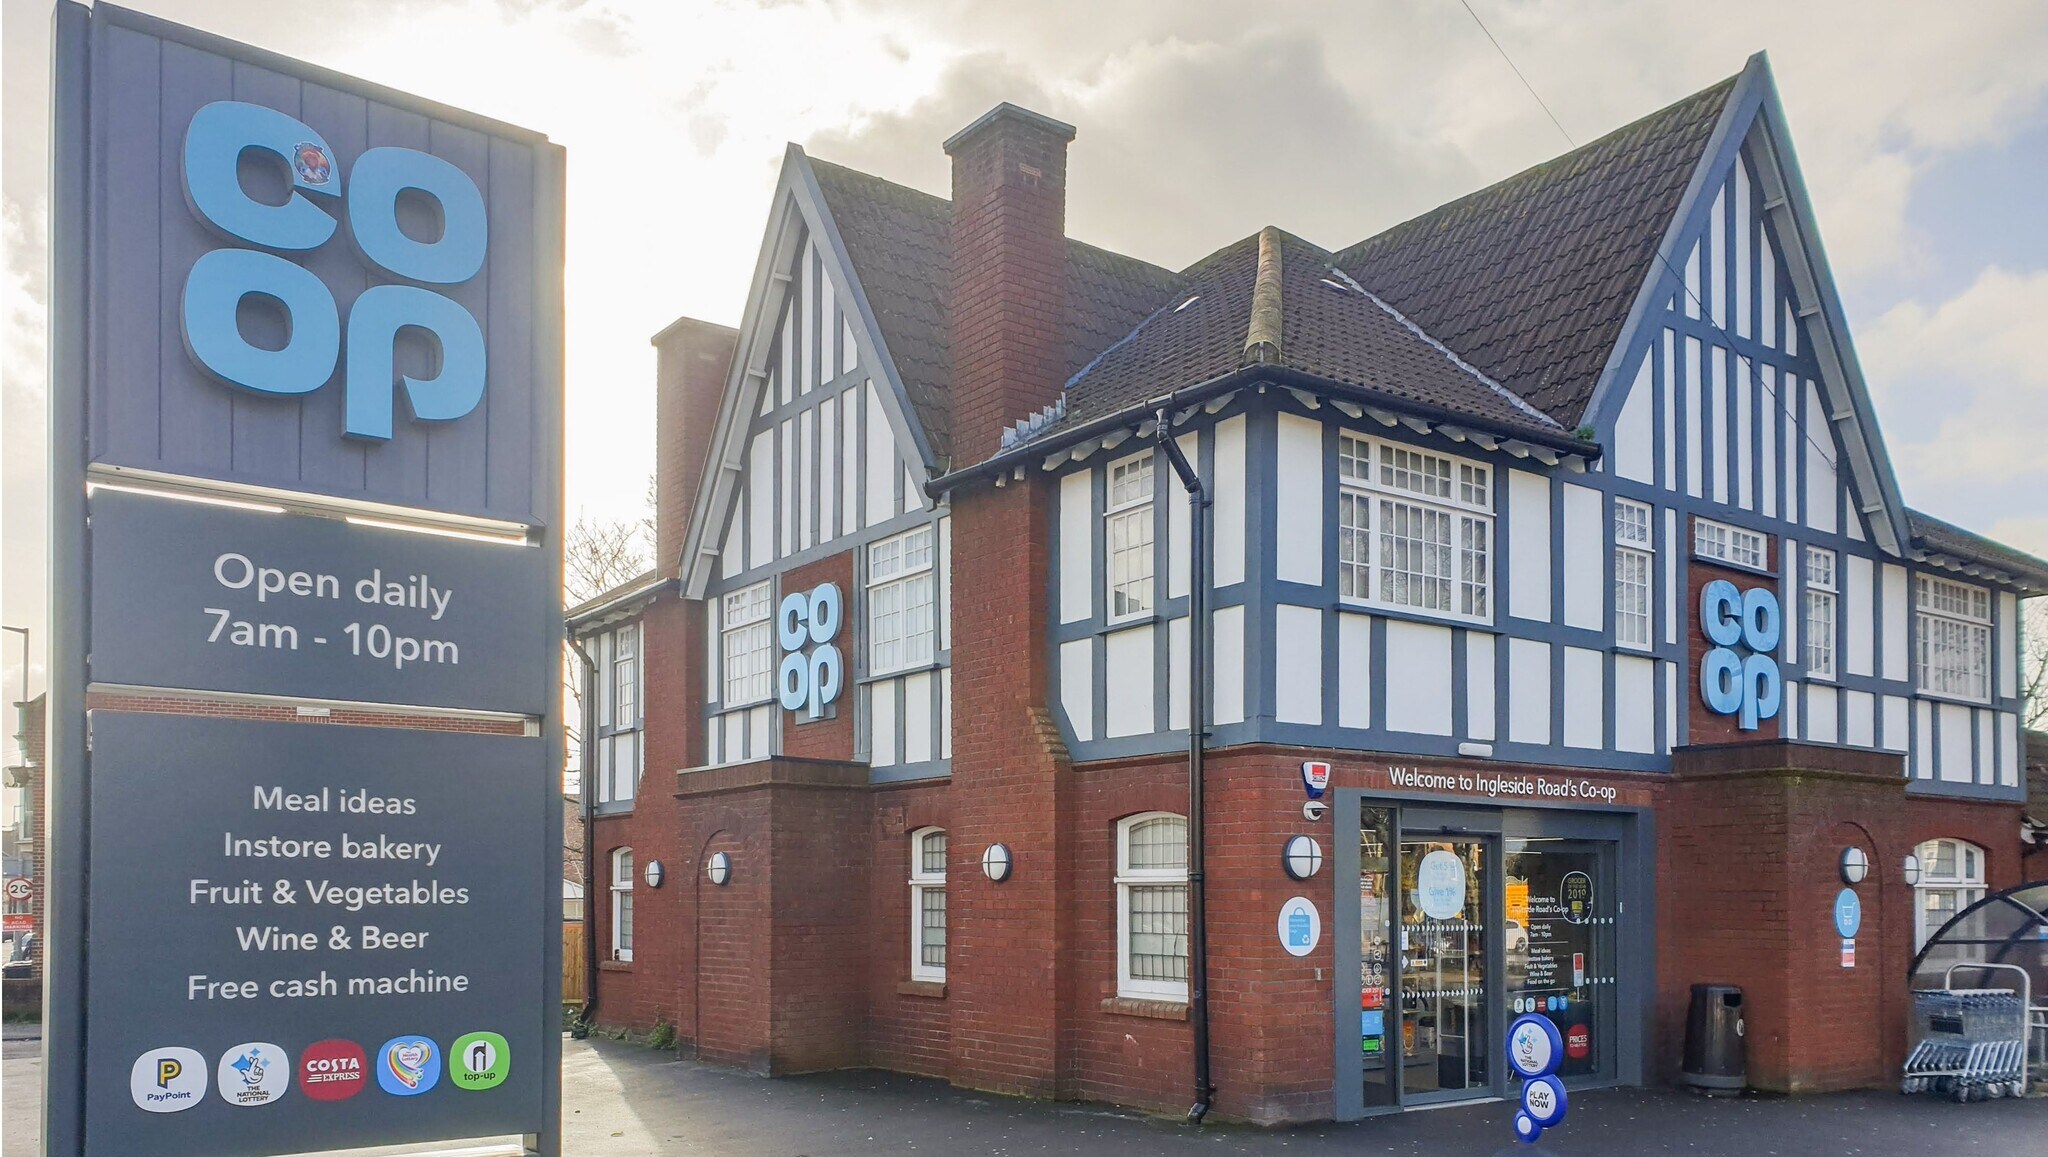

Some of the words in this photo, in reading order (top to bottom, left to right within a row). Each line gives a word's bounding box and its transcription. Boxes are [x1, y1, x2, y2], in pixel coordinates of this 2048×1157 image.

[214, 553, 339, 602] Open
[355, 568, 452, 620] daily
[204, 608, 298, 650] 7am
[343, 622, 458, 669] 10pm
[1389, 767, 1455, 789] Welcome
[1459, 774, 1473, 791] to
[1476, 773, 1534, 797] Ingleside
[1537, 778, 1577, 797] Road's
[1580, 780, 1617, 803] Co-op
[253, 785, 329, 812] Meal
[340, 788, 417, 815] ideas
[224, 832, 331, 858] Instore
[342, 833, 441, 866] bakery
[10, 884, 28, 894] 20
[1567, 888, 1587, 899] 2019
[190, 879, 263, 904] Fruit
[272, 879, 297, 904] &
[305, 879, 470, 911] Vegetables
[1535, 904, 1553, 913] Road's
[1553, 904, 1569, 915] Co-op
[1530, 923, 1542, 932] Open
[236, 926, 318, 951] Wine
[328, 925, 352, 950] &
[362, 925, 429, 950] Beer
[188, 975, 259, 1000] Free
[269, 970, 337, 998] cash
[348, 968, 469, 995] machine
[1569, 1035, 1588, 1044] PRICES
[306, 1057, 360, 1073] COSTA
[322, 1071, 360, 1082] EXPRESS
[464, 1073, 496, 1082] top-up
[147, 1091, 191, 1102] PayPoint
[237, 1090, 271, 1098] NATIONAL
[1529, 1091, 1550, 1100] PLAY
[1529, 1099, 1549, 1109] NOW
